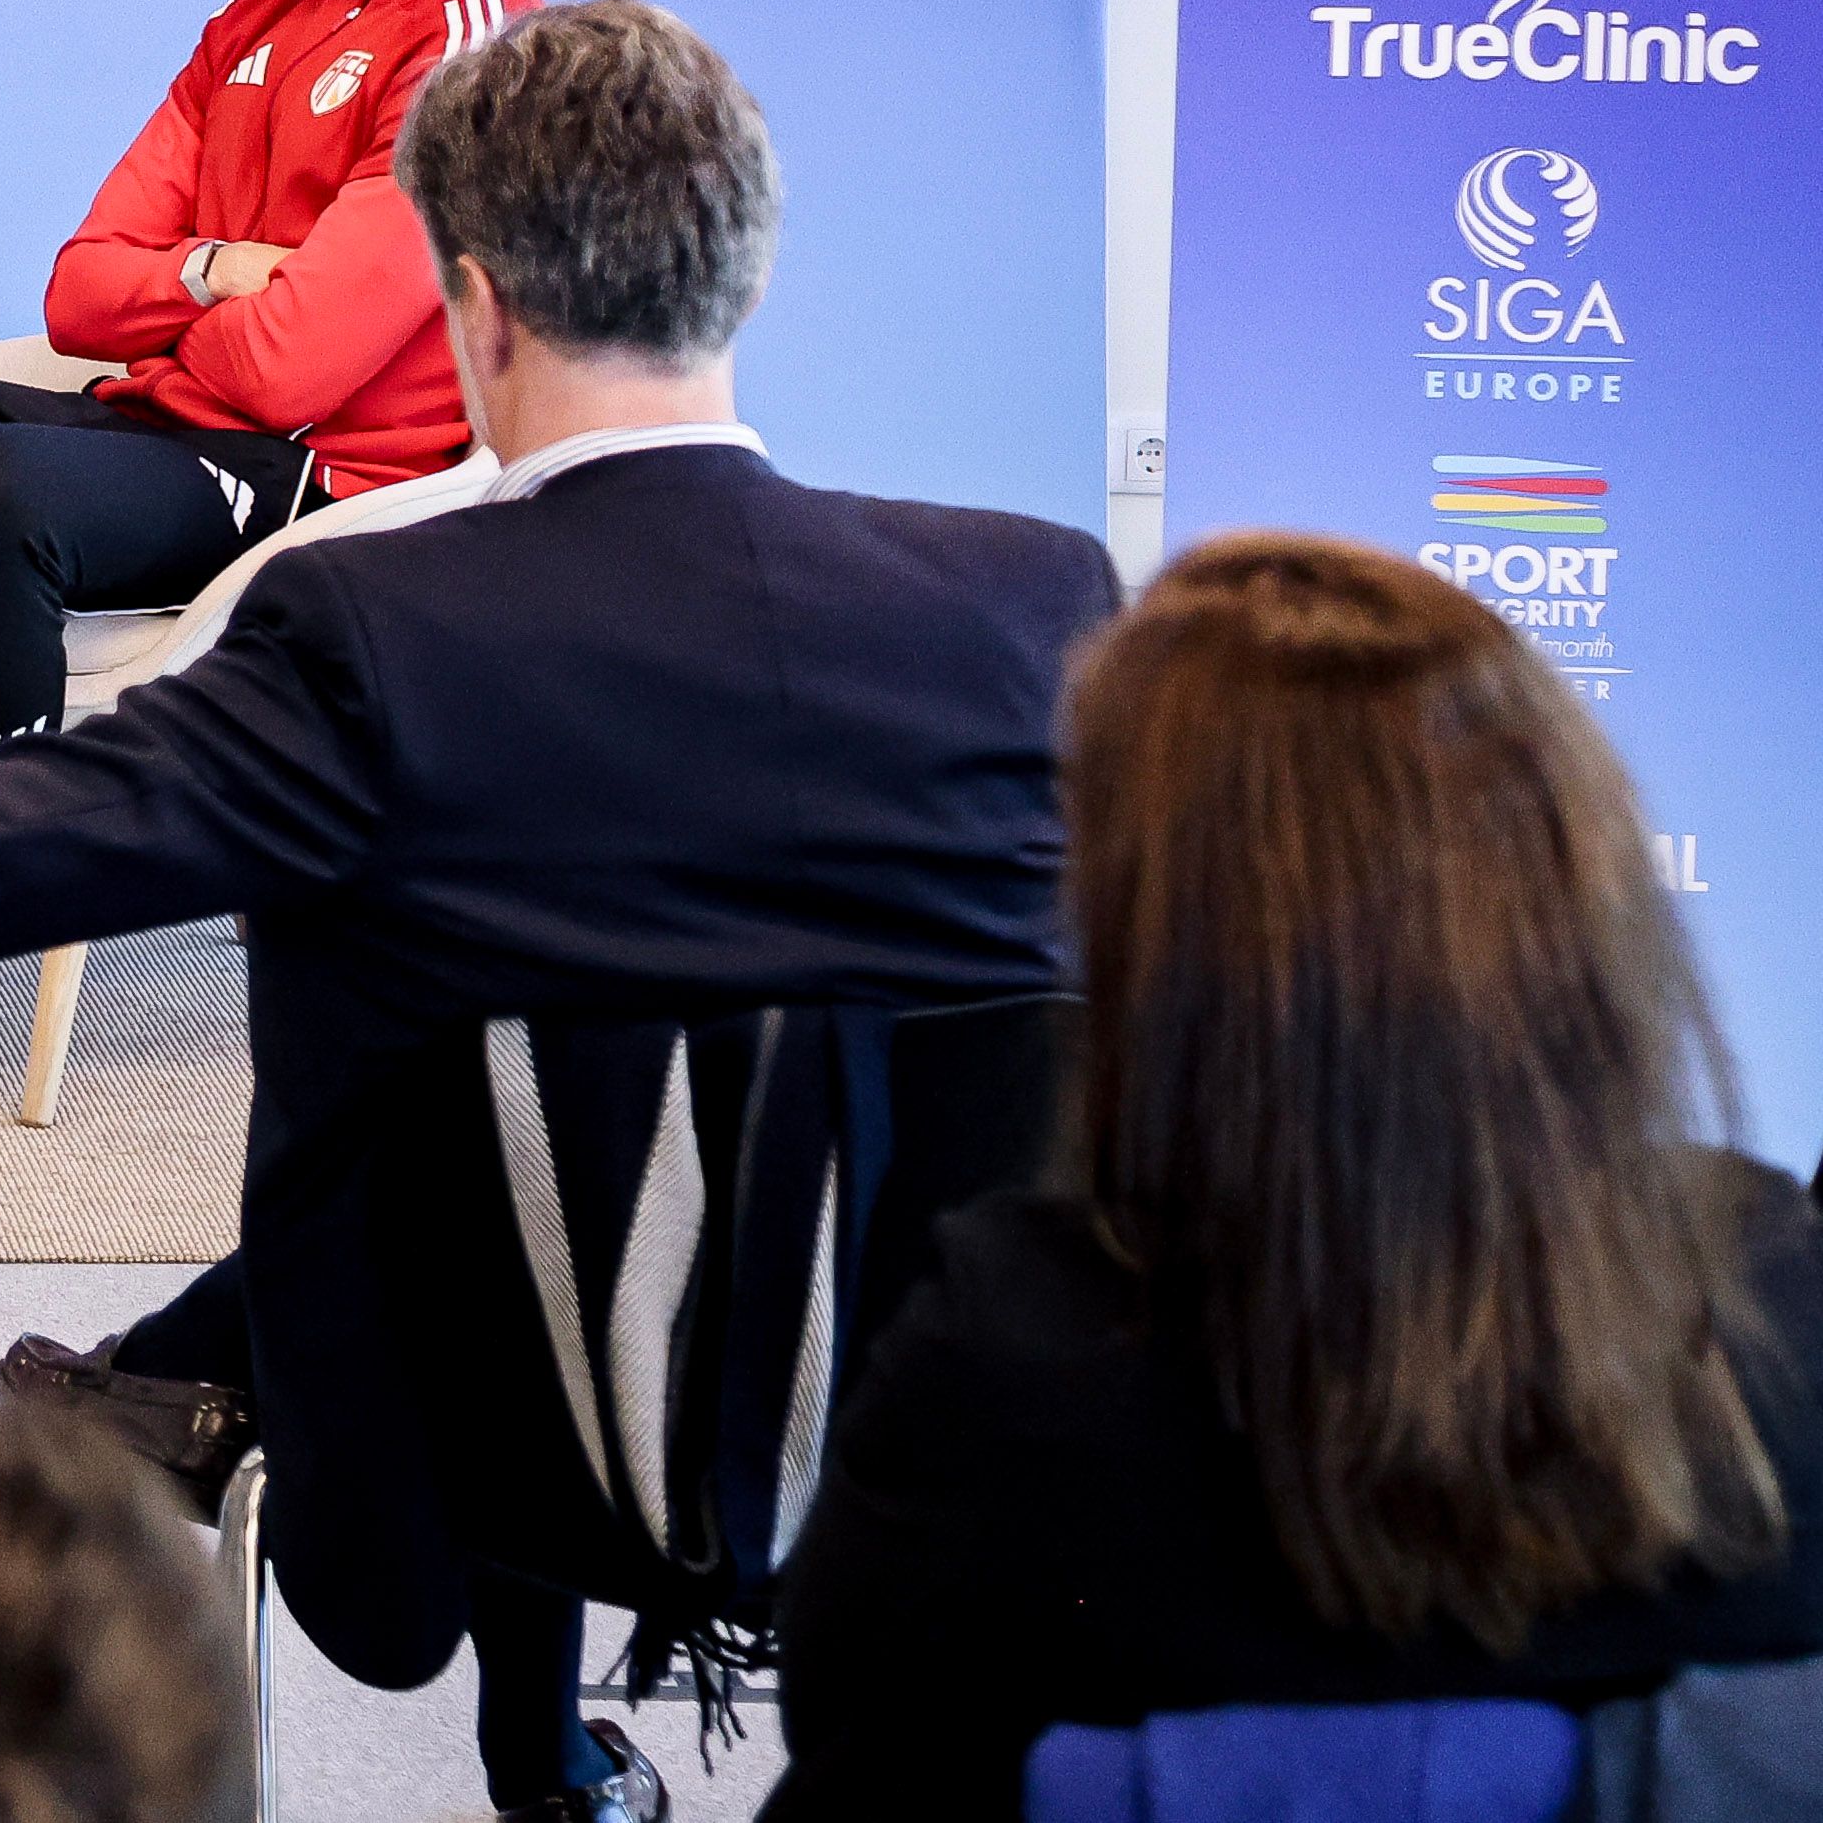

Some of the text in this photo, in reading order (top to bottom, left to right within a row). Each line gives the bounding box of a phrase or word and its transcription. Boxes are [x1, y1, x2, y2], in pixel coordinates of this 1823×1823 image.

[1310, 6, 1761, 84] TrueClinic
[1423, 277, 1625, 344] SIGA
[1425, 370, 1622, 403] EUROPE
[1417, 542, 1619, 596] SPORT
